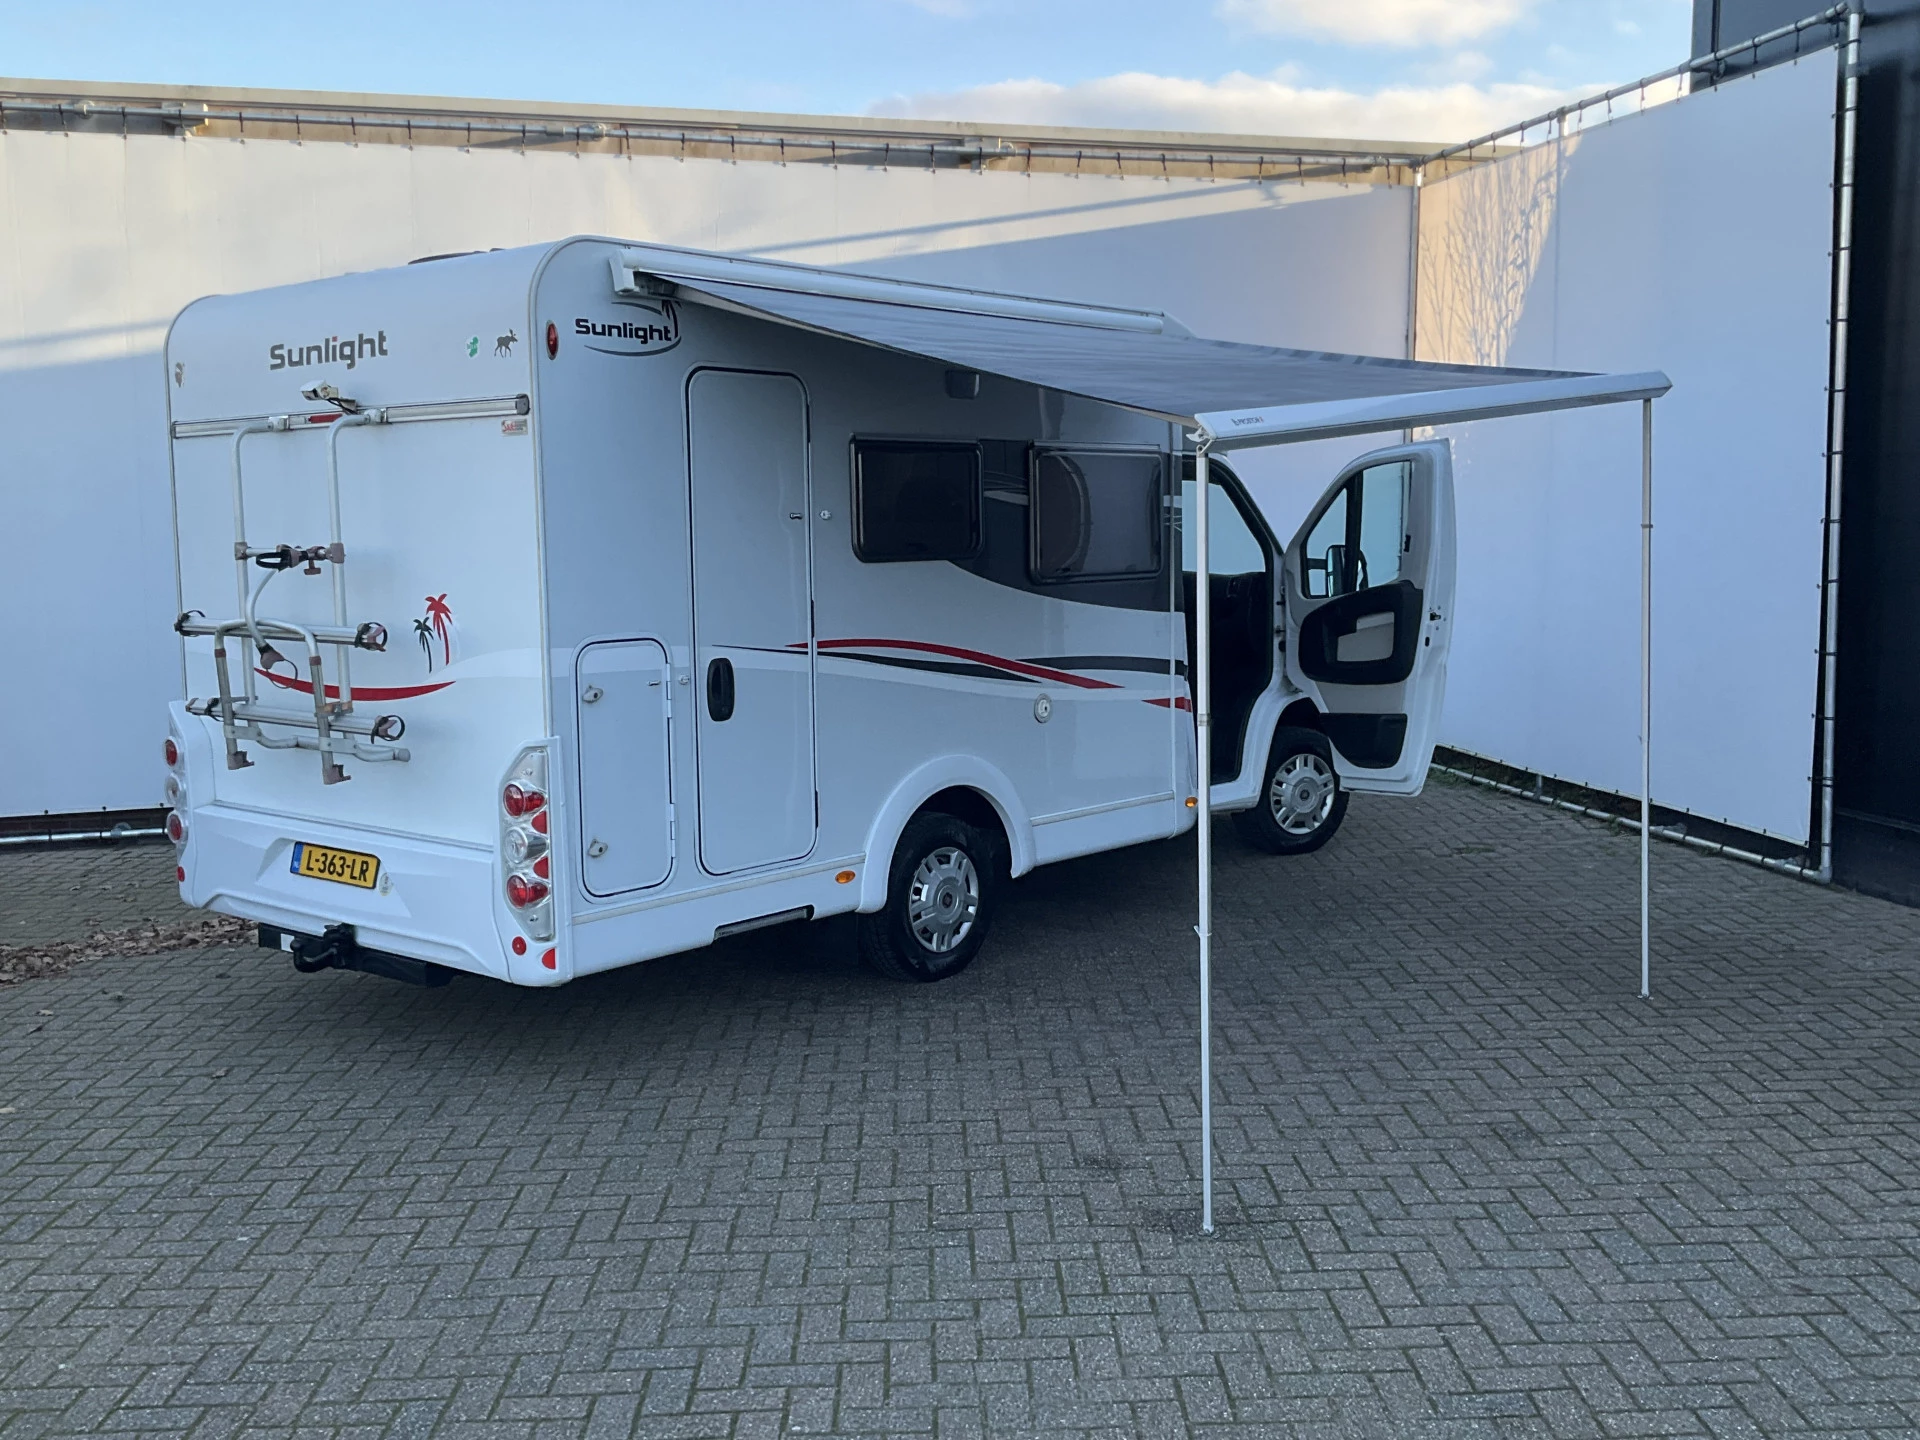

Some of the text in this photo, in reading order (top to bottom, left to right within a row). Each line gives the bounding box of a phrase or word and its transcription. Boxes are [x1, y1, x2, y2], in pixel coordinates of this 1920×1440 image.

[575, 318, 672, 344] Sunlight
[269, 330, 388, 370] Sunlight
[306, 850, 369, 883] L-363-LR
